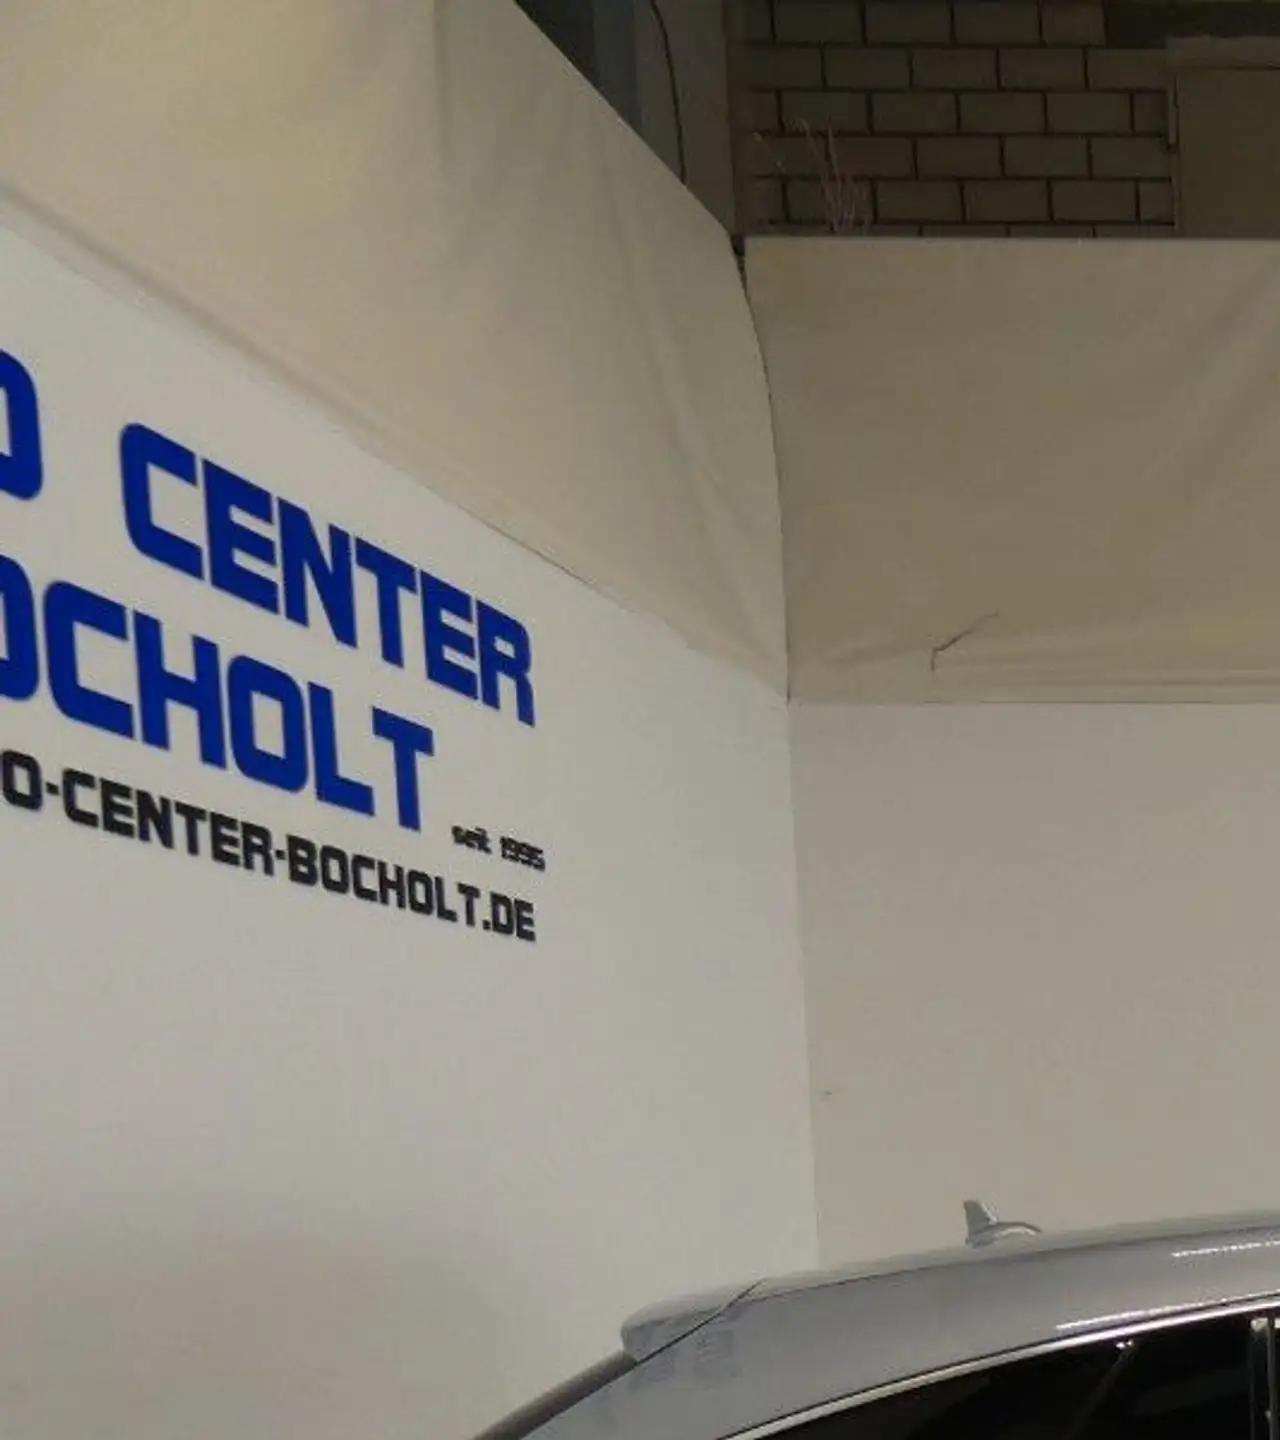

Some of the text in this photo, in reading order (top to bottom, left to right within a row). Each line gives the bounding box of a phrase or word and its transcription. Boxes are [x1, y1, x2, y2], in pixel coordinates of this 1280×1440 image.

[120, 423, 536, 728] CENTER
[451, 825, 546, 873] seit 1995
